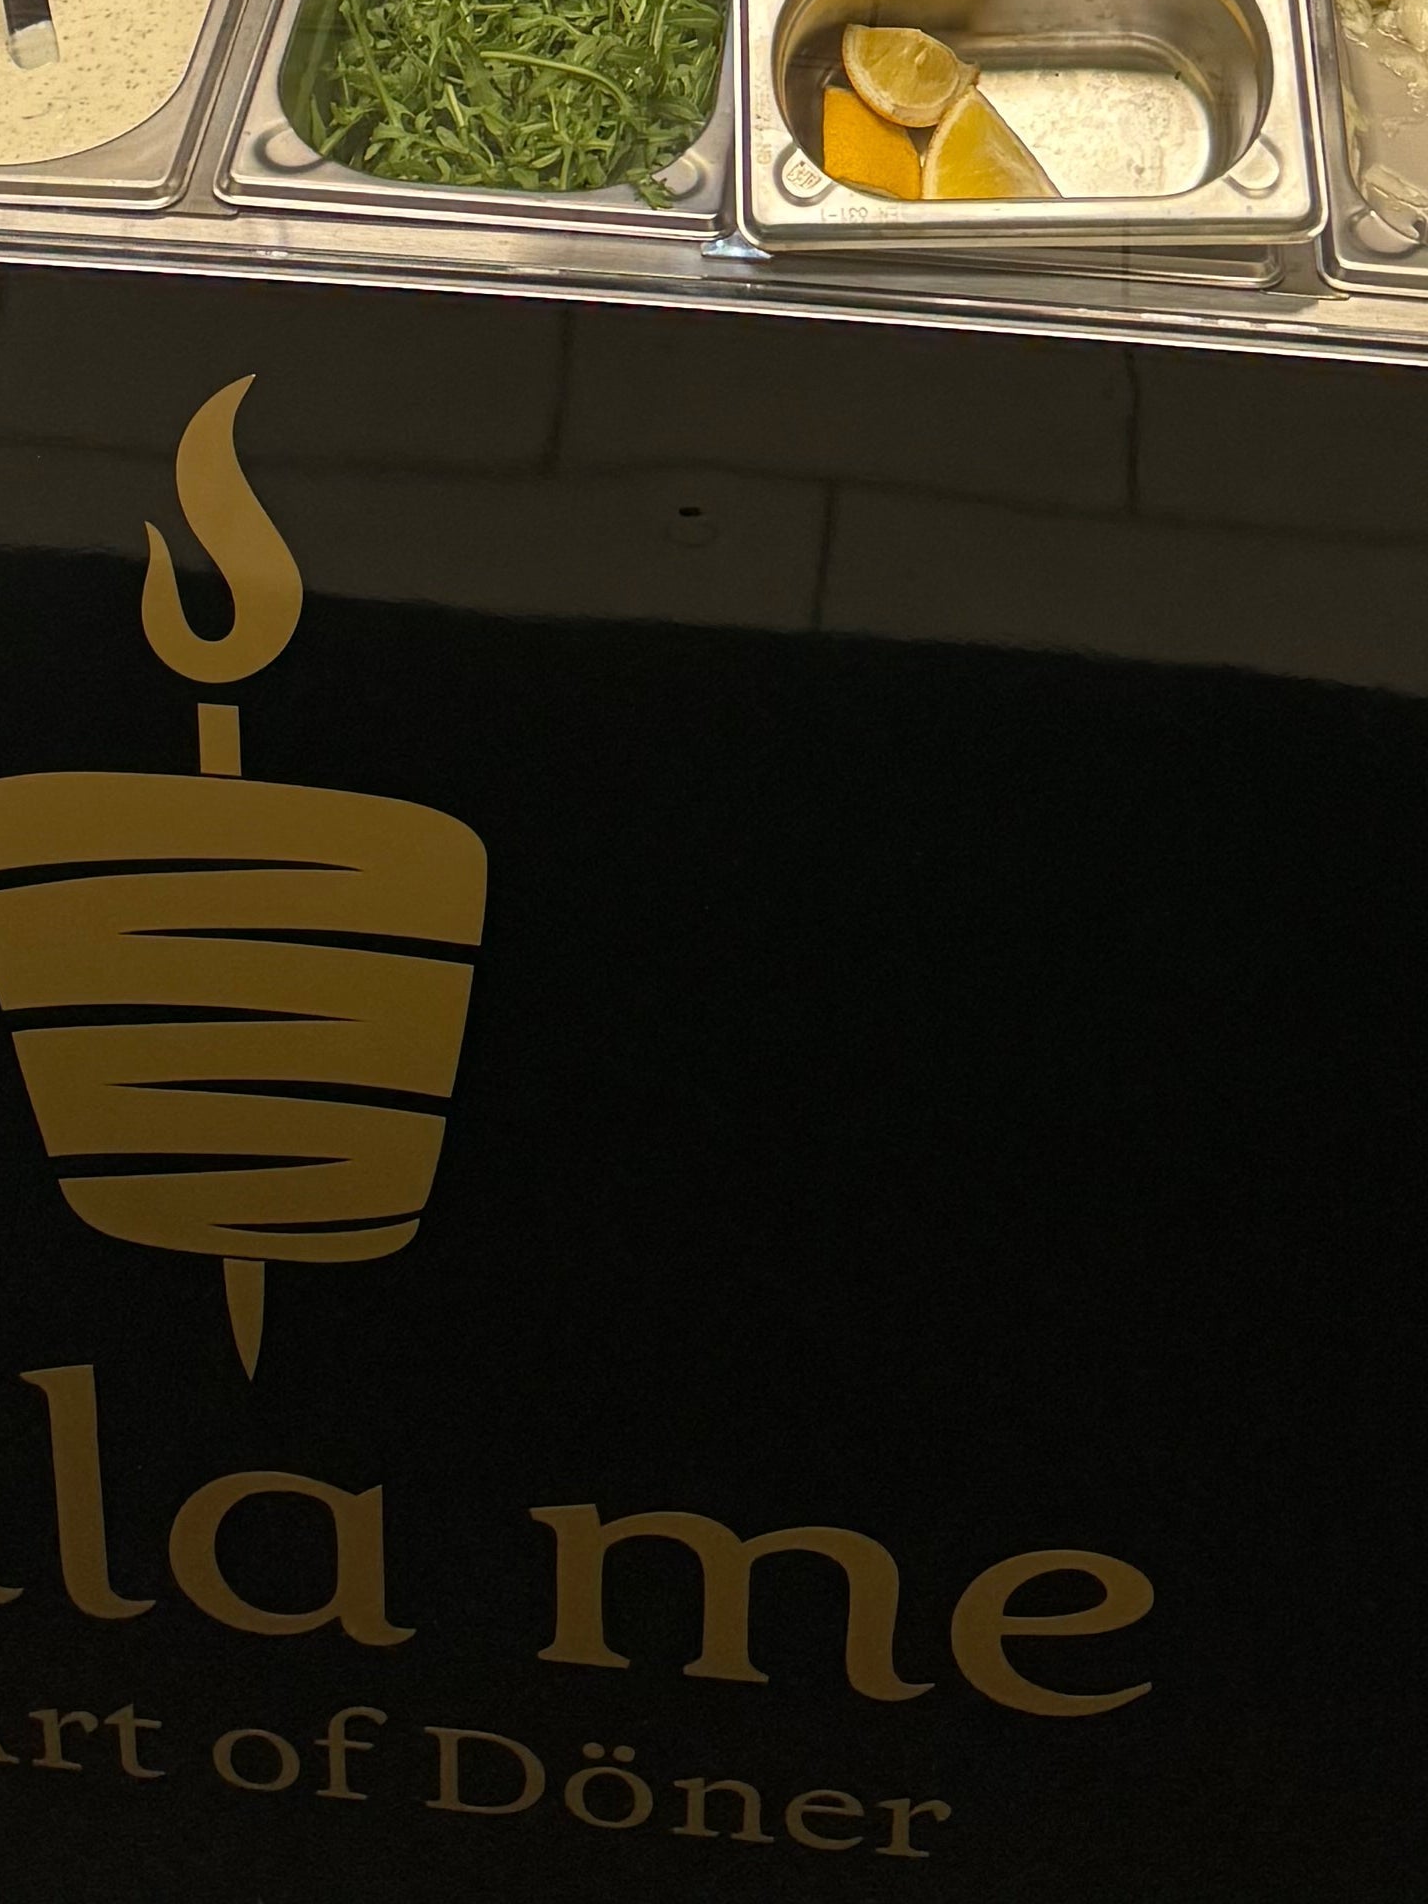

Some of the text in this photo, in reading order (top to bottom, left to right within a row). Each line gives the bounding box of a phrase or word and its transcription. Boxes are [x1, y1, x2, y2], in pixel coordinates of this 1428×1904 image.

[531, 1505, 1153, 1717] me
[213, 1706, 392, 1800] of
[424, 1729, 951, 1856] Döner
